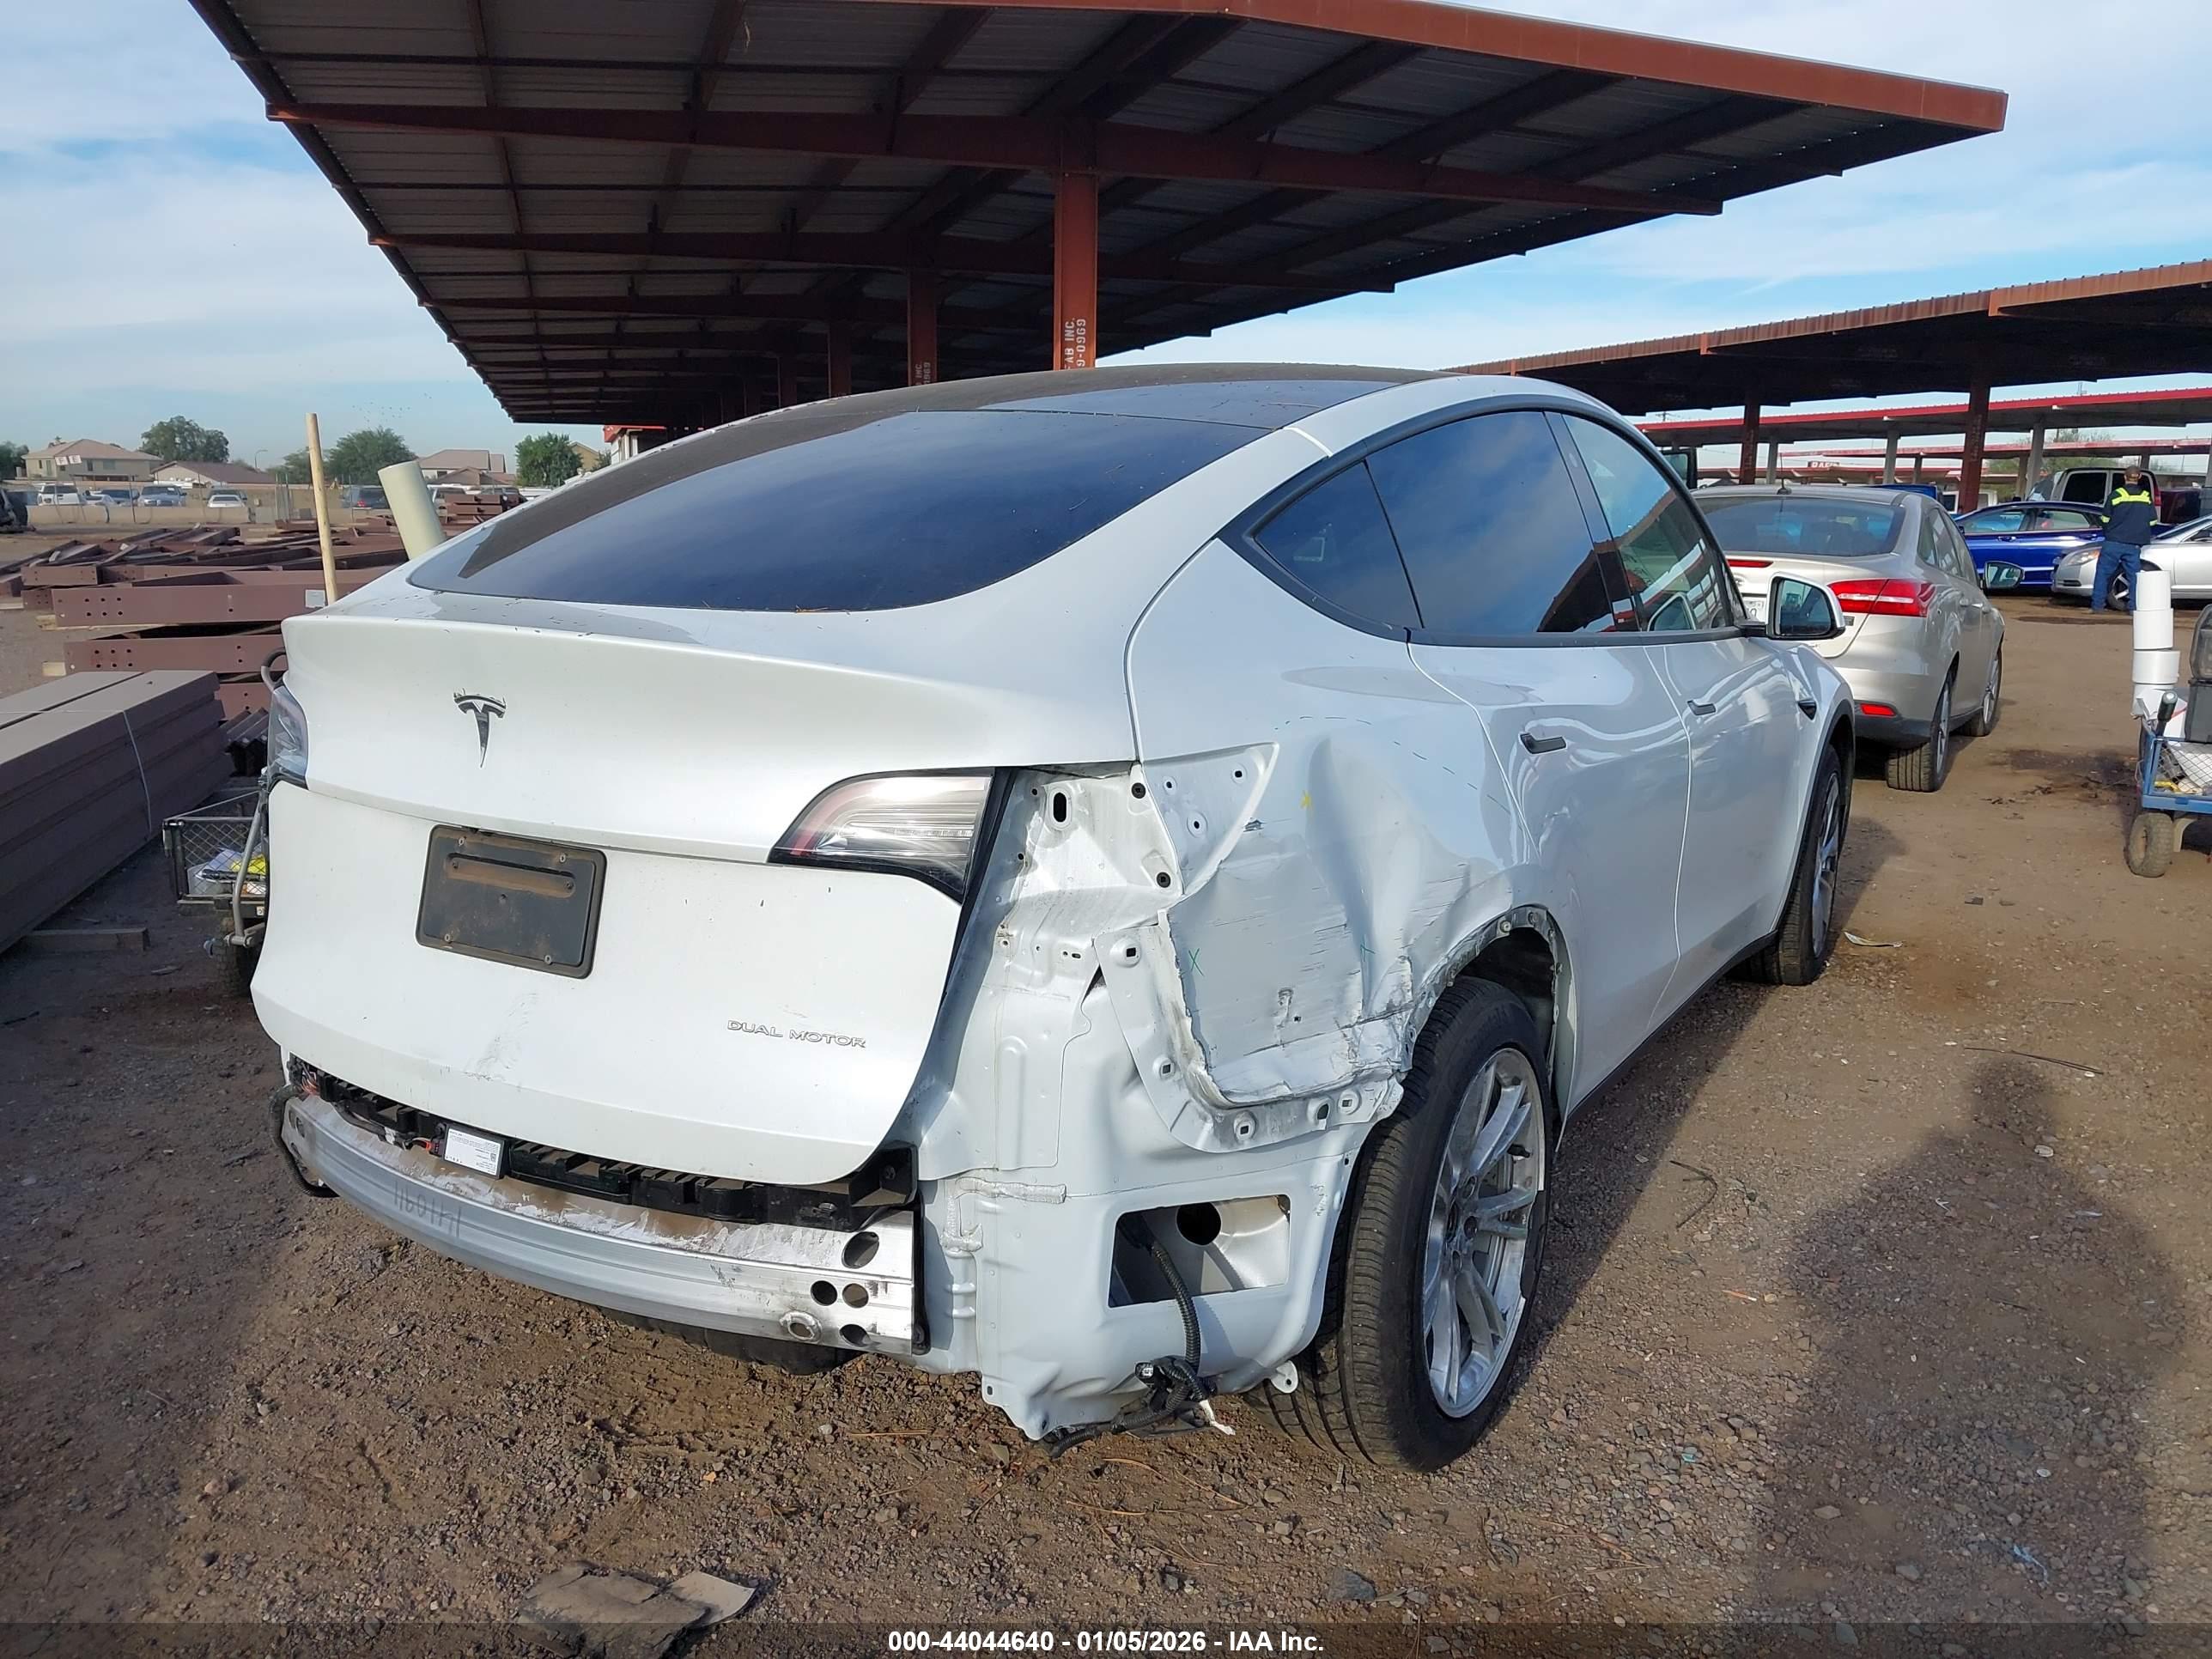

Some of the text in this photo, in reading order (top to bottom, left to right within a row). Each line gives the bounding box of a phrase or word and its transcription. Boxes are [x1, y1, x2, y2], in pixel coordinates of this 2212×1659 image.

[1065, 318, 1075, 341] INC.
[727, 1019, 866, 1048] DUAL MOTOR
